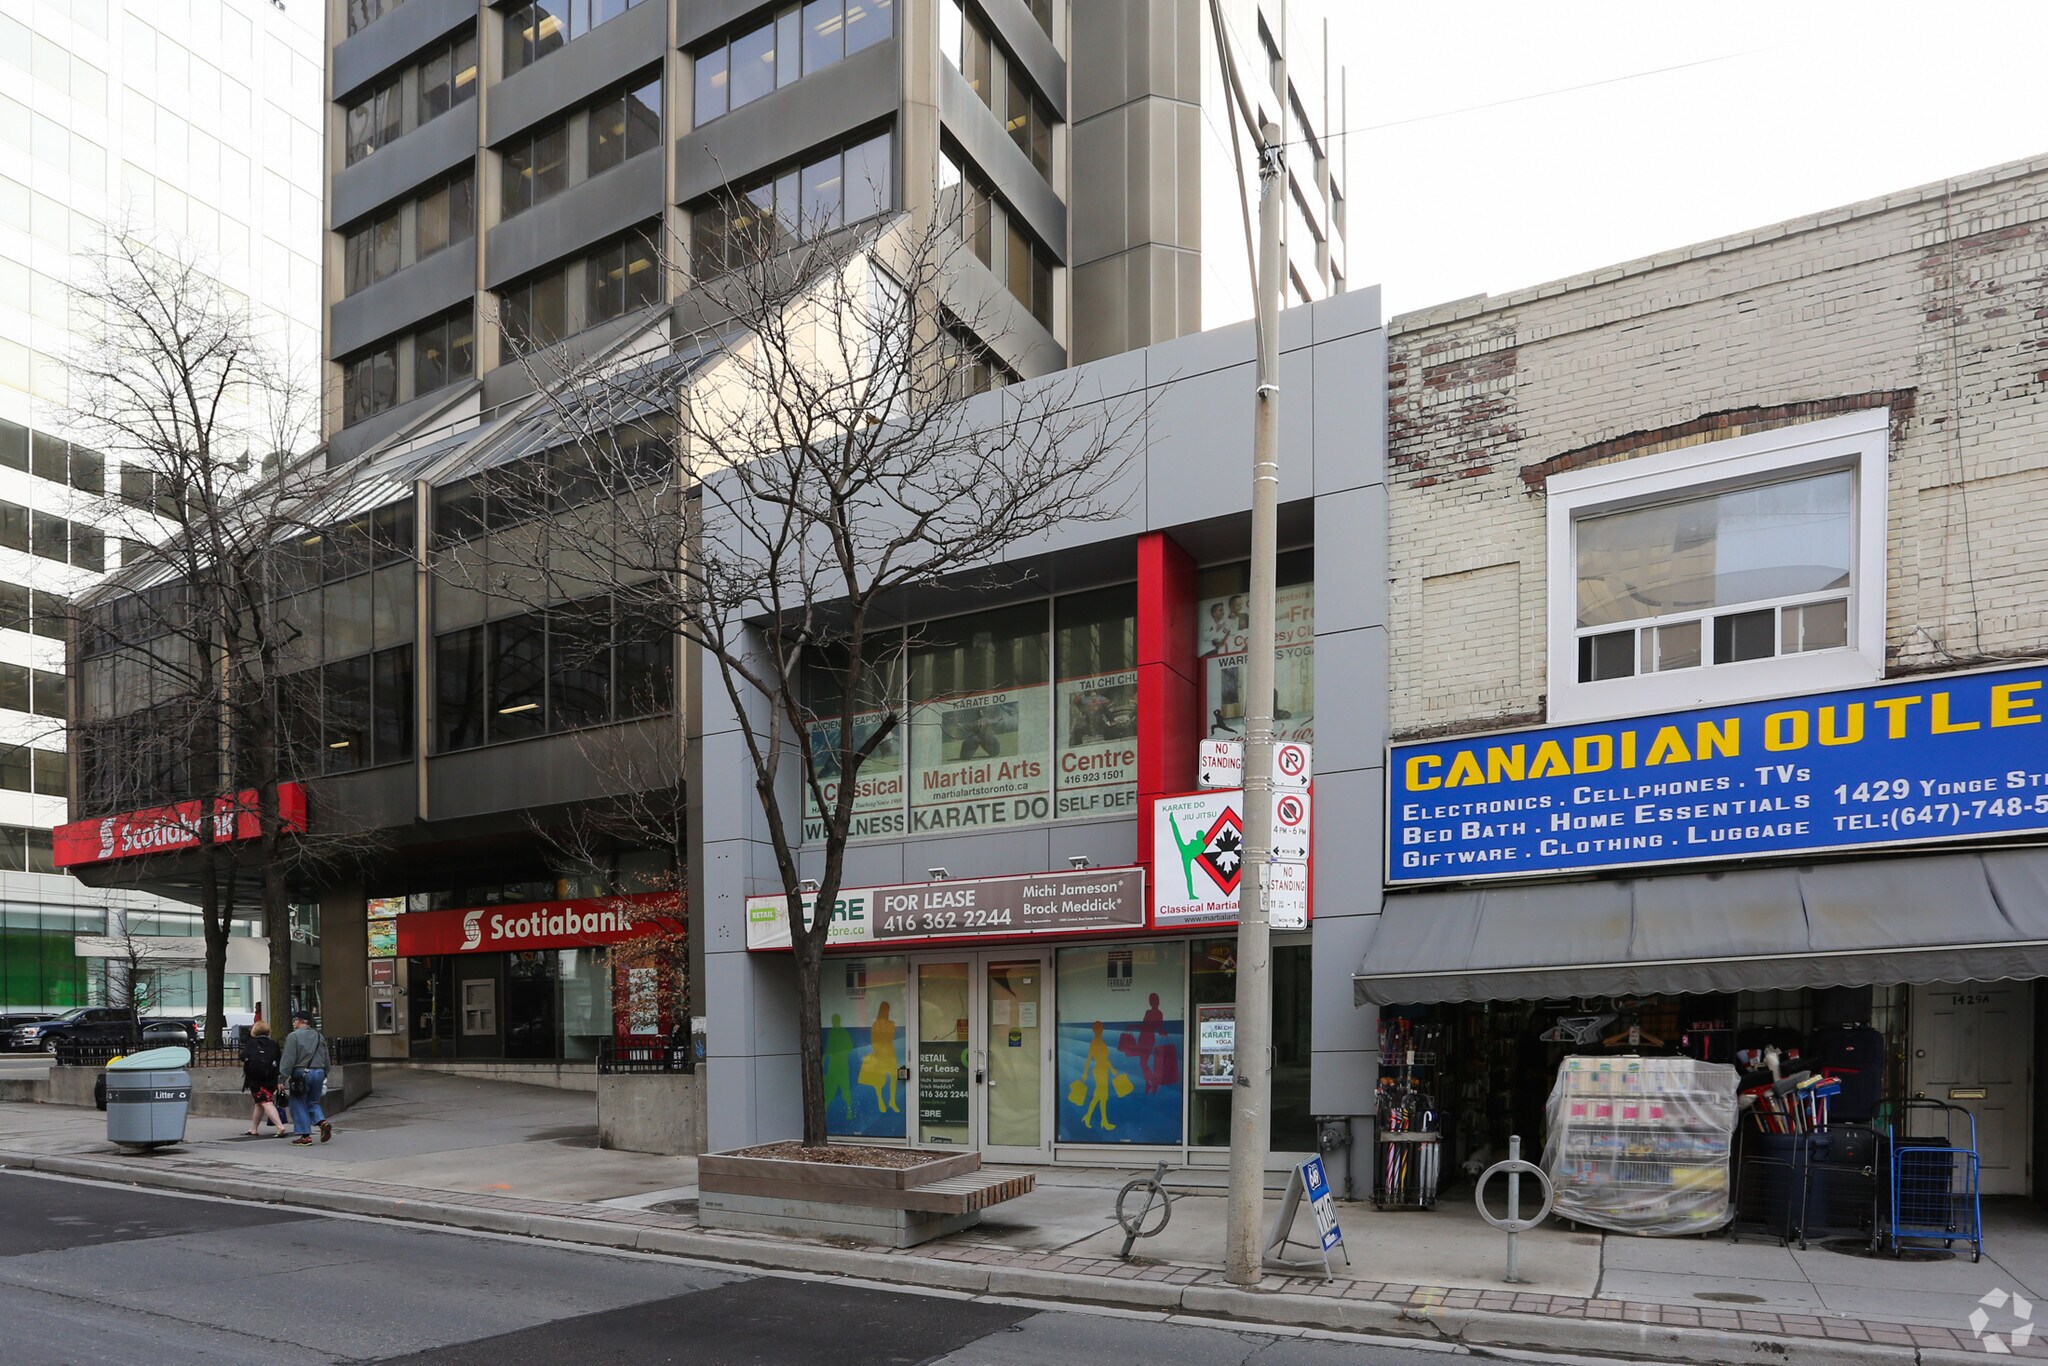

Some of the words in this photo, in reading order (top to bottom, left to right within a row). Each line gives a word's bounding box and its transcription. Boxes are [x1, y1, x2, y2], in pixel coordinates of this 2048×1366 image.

[1080, 680, 1094, 690] TAI
[1098, 677, 1115, 688] CHI
[953, 696, 990, 710] KARATE
[992, 694, 1006, 704] DO
[1405, 718, 1740, 792] CANADIAN
[1764, 680, 2042, 752] OUTLE
[1216, 743, 1228, 754] NO
[1202, 756, 1241, 770] STANDING
[824, 775, 903, 802] Clssical
[924, 764, 990, 790] Martial
[998, 760, 1040, 780] Arts
[1062, 749, 1135, 772] Centre
[1064, 775, 1080, 784] 416
[1082, 772, 1100, 782] 923
[1102, 770, 1124, 780] 1501
[932, 782, 1028, 800] martialartstoronto.ca
[1834, 778, 1910, 805] 1429
[1403, 796, 1552, 822] ELECTRONICS
[1574, 776, 1730, 804] CELLPHONES
[914, 802, 1006, 831] KARATE
[1014, 797, 1049, 820] DO
[1059, 795, 1100, 812] SELF
[1104, 791, 1138, 808] DEF
[1162, 802, 1192, 812] KARATE
[1182, 812, 1194, 821] JIU
[1196, 811, 1217, 820] JITSU
[1403, 826, 1452, 845] BED
[1462, 822, 1526, 840] BATH
[1550, 812, 1625, 832] HOME
[1634, 794, 1810, 824] ESSENTIALS
[1292, 826, 1297, 834] 6
[1402, 847, 1517, 868] GIFTWARE
[1540, 834, 1663, 856] CLOTHING
[1688, 821, 1810, 844] LUGGAGE
[1283, 866, 1292, 878] NO
[1023, 884, 1056, 898] Michi
[1270, 880, 1304, 892] STANDING
[884, 894, 918, 912] FOR
[924, 890, 976, 910] LEASE
[1160, 904, 1204, 914] Classical
[1206, 900, 1240, 912] Martial
[752, 911, 775, 920] RETAIL
[801, 898, 864, 924] CRE
[1024, 902, 1058, 916] Brock
[490, 904, 632, 940] Scotiabank
[884, 914, 917, 932] 416
[922, 911, 957, 930] 362
[964, 908, 1012, 928] 2244
[935, 1064, 960, 1073] Lease
[155, 1091, 174, 1100] Litter
